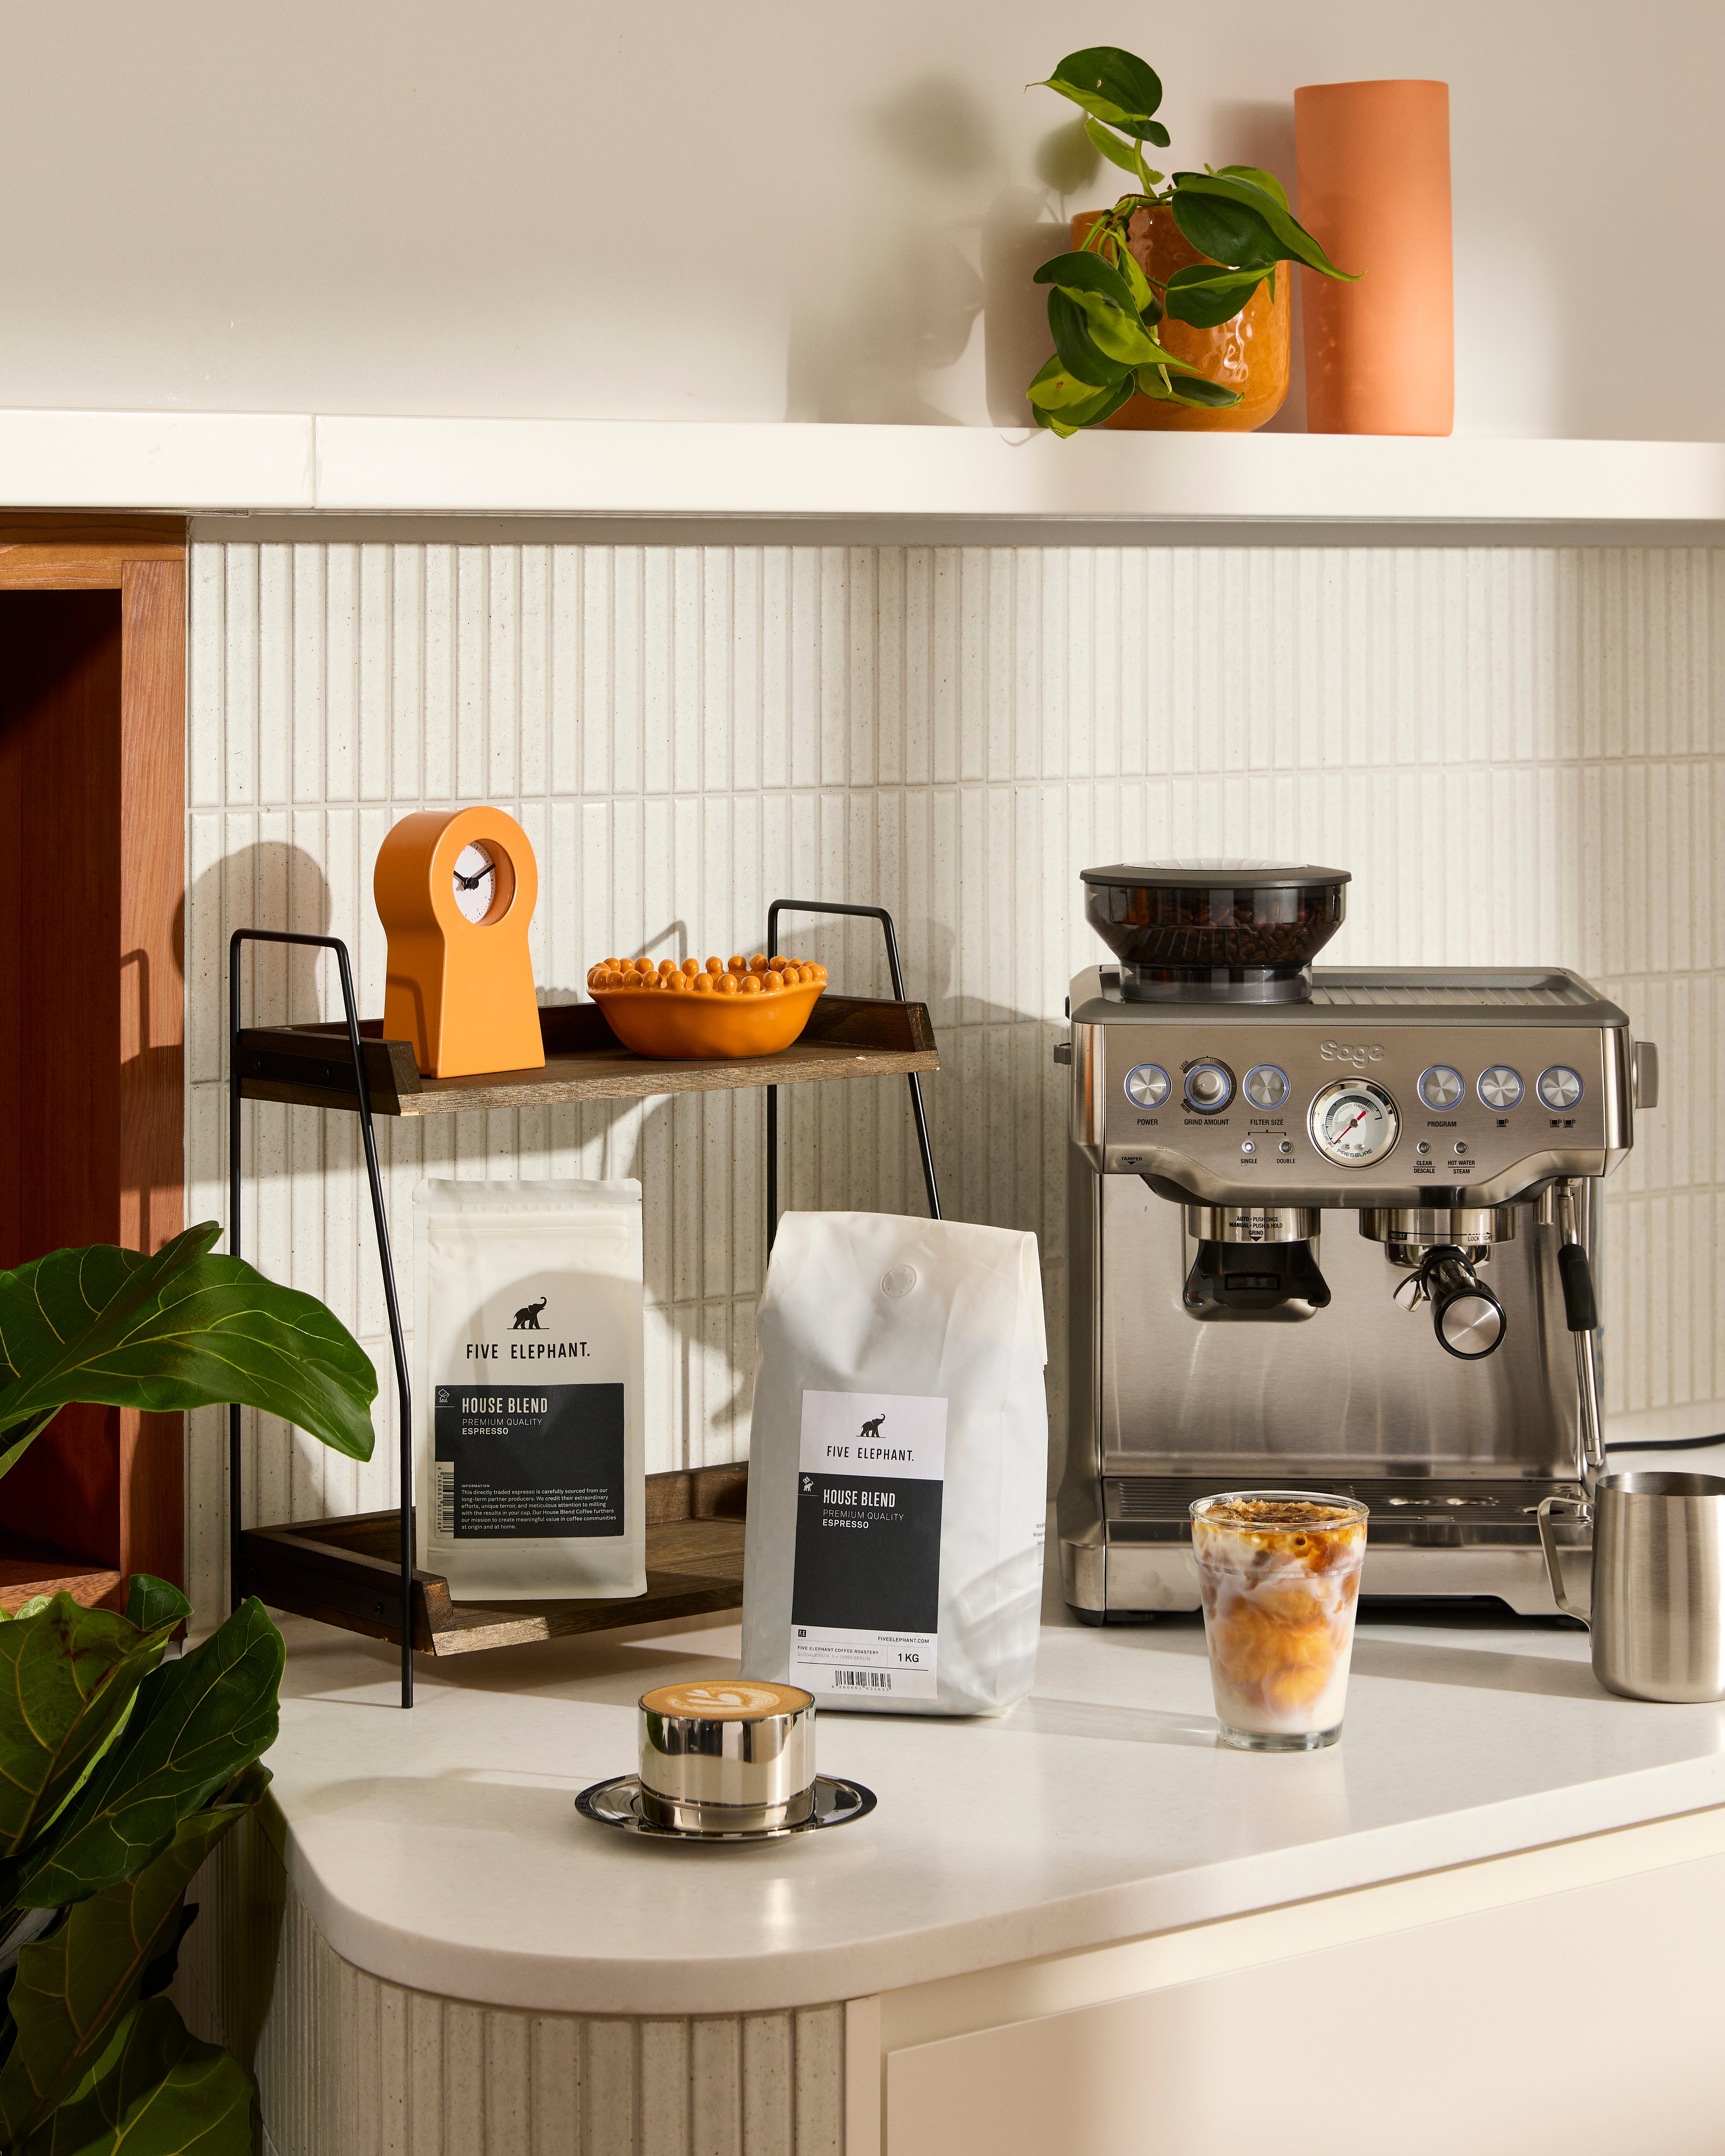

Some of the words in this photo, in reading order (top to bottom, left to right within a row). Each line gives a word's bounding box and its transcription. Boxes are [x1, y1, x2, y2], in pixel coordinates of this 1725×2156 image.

[1321, 1040, 1385, 1069] Sage
[1179, 1060, 1189, 1070] LESS
[1180, 1103, 1191, 1114] MORE
[1334, 1104, 1352, 1124] ESPRESSO
[1354, 1104, 1370, 1114] RANGE
[1321, 1124, 1334, 1148] PRE-INFUSION
[1337, 1148, 1373, 1157] PRESSURE
[467, 1344, 498, 1359] FIVE
[511, 1342, 590, 1359] ELEPHANT.
[462, 1398, 503, 1413] HOUSE
[509, 1398, 547, 1413] BLEND
[827, 1446, 850, 1458] FIVE
[858, 1447, 915, 1461] ELEPHANT.
[823, 1489, 858, 1505] HOUSE
[861, 1491, 896, 1508] BLEND
[823, 1509, 864, 1520] PREMIUM
[867, 1511, 904, 1521] QUALITY
[823, 1519, 869, 1529] ESPRESSO
[898, 1653, 902, 1661] 1
[905, 1654, 919, 1662] KG
